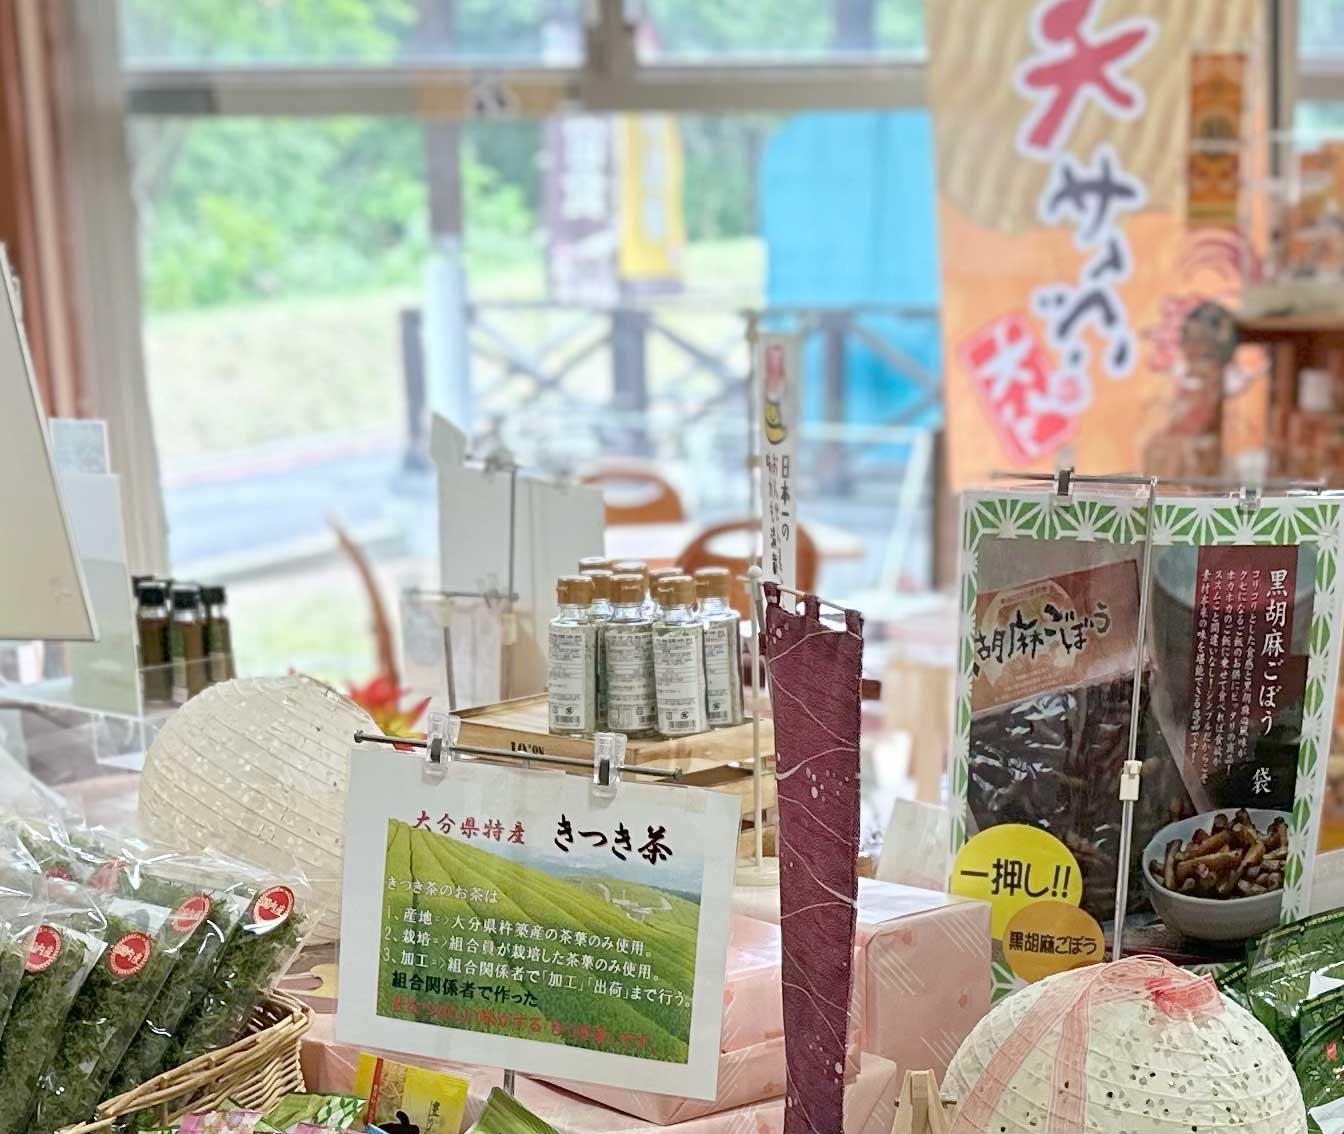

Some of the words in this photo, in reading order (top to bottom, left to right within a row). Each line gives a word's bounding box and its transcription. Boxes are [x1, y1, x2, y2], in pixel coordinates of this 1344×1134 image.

[1259, 569, 1289, 738] 黒胡麻ごぼう
[1251, 767, 1272, 795] 袋
[412, 810, 527, 845] 大分県特産
[552, 813, 674, 865] きつき茶
[385, 875, 499, 905] きつき茶のお茶は
[1008, 931, 1097, 955] 黒胡麻ごぼう
[391, 969, 540, 1008] 組合関係者で作った
